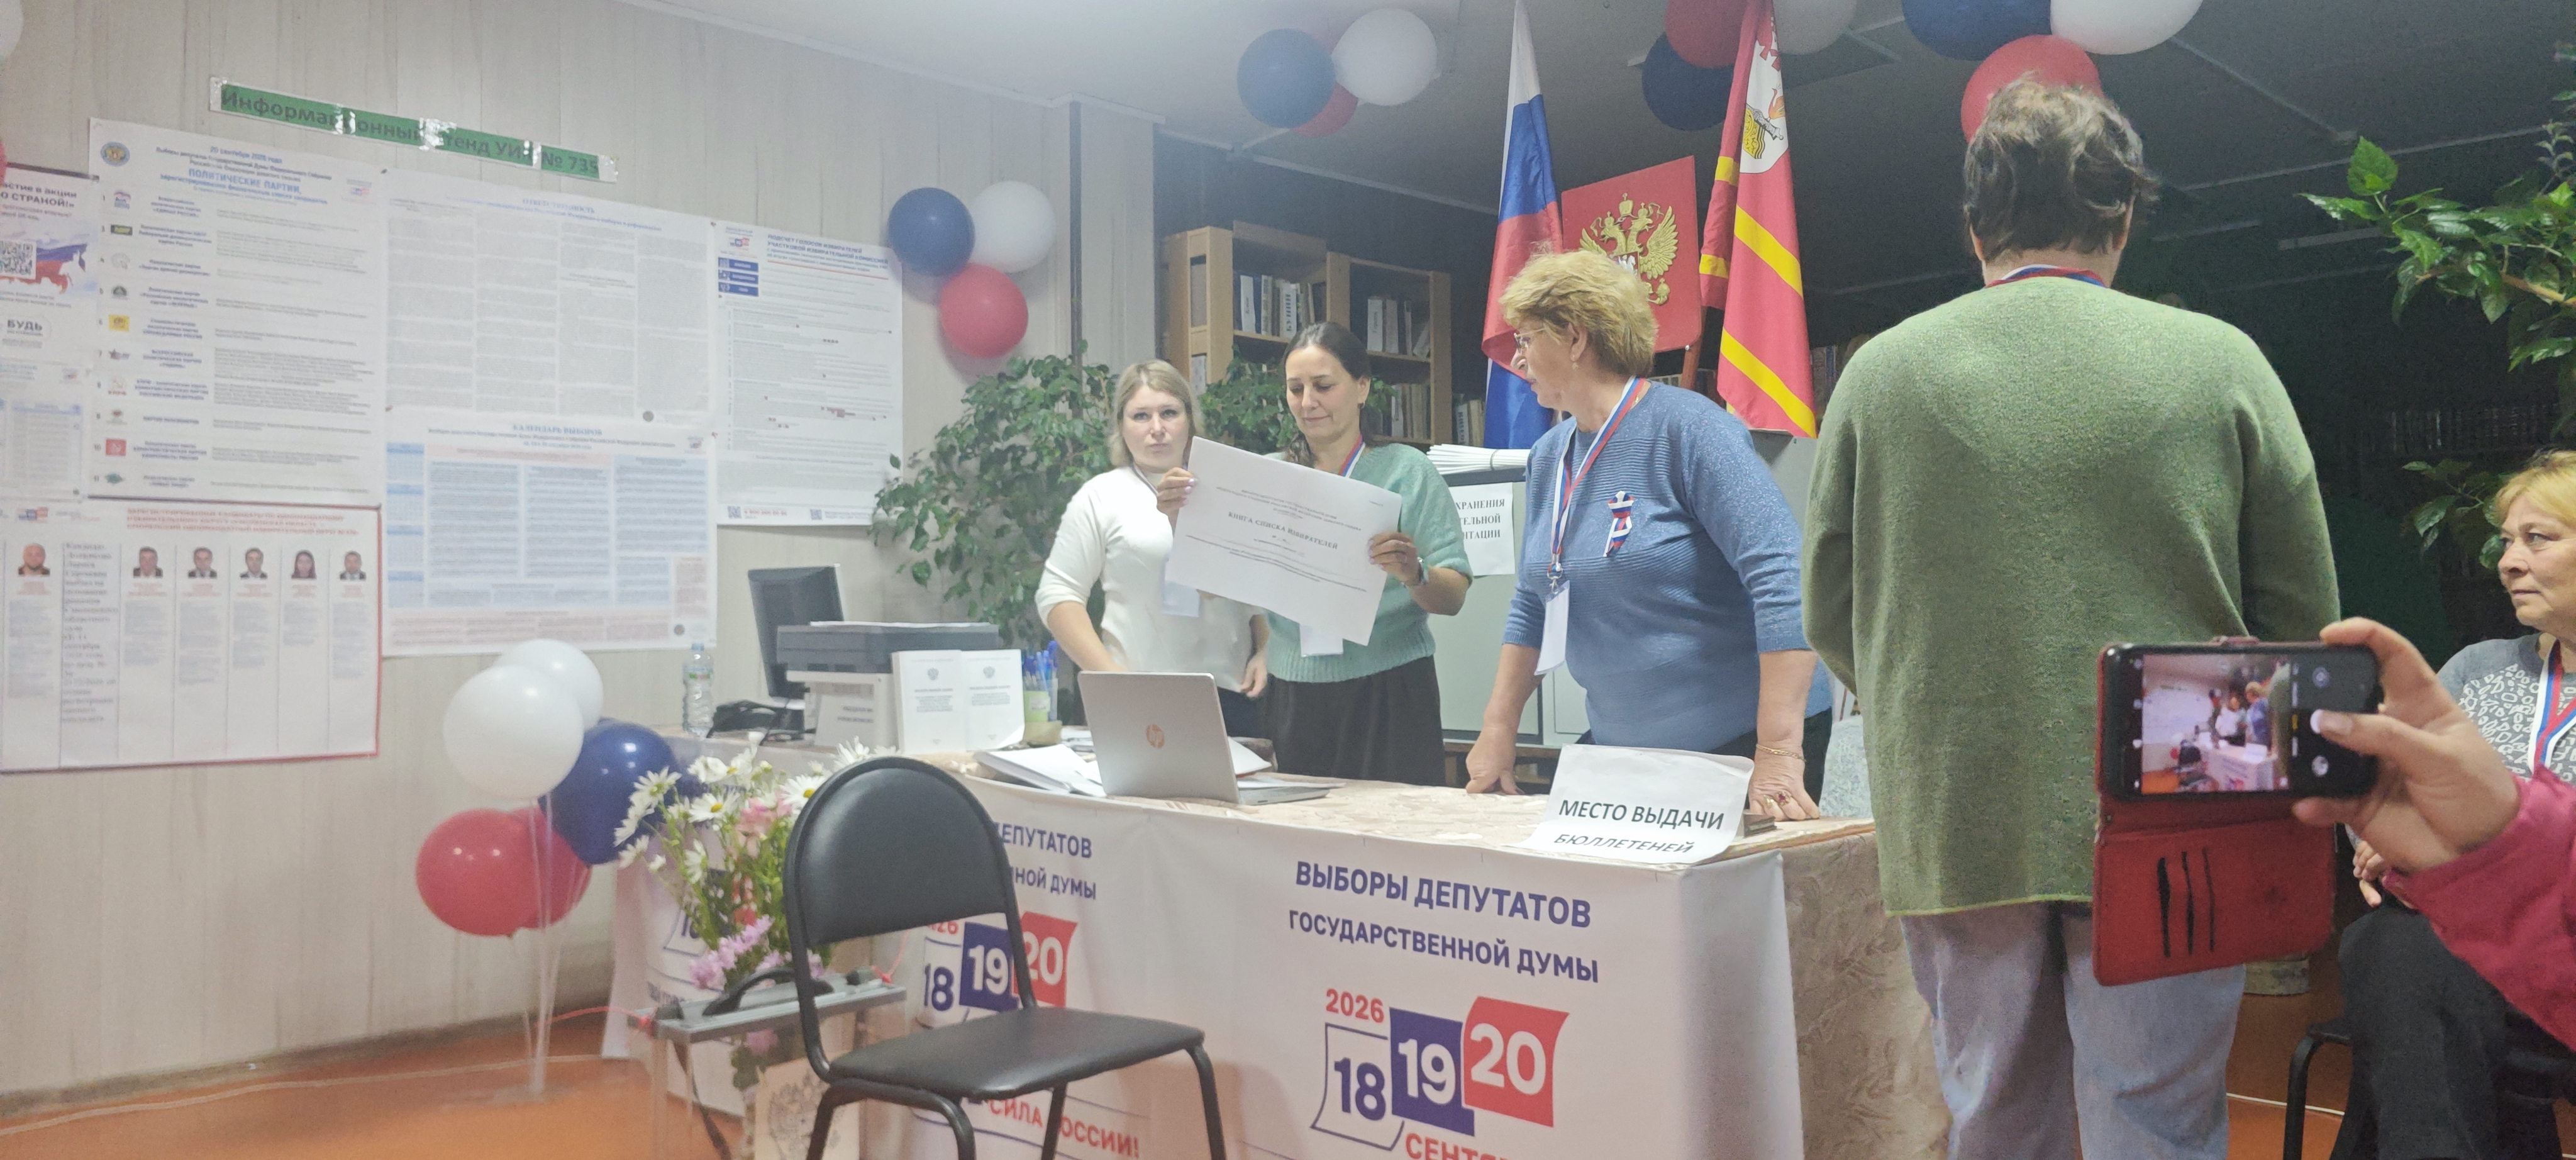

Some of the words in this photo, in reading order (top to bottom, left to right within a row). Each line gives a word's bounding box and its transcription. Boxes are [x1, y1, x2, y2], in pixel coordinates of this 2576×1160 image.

[439, 131, 491, 157] тенд
[541, 152, 562, 169] №
[567, 155, 599, 175] 735
[189, 167, 260, 188] ПОЛИТИЧЕСКИЕ
[767, 240, 806, 252] УЧАСТКОВОЙ
[807, 246, 855, 259] ИЗБИРАТЕЛЬНОЙ
[7, 318, 43, 332] БУДЬ
[1228, 511, 1253, 524] КНИГА
[1255, 519, 1286, 533] СПИСКА
[1287, 527, 1338, 550] ИЗБИРАТЕЛЕЙ
[1558, 800, 1628, 821] МЕСТО
[1631, 805, 1725, 830] ВЫДАЧИ
[994, 822, 1092, 859] ЕПУТАТОВ
[1553, 833, 1697, 854] БЮЛЛЕТЕНЕЙ
[1050, 873, 1096, 900] ДУМЫ
[1296, 861, 1408, 901] ВЫБОРЫ
[1414, 878, 1592, 929] ДЕПУТАТОВ
[1289, 910, 1511, 969] ГОСУДАРСТВЕННОЙ
[1516, 947, 1599, 984] ДУМЫ
[924, 962, 955, 1012] 18
[968, 944, 1009, 995] 19
[1023, 931, 1064, 986] 20
[1325, 988, 1385, 1024] 2026
[1333, 1057, 1387, 1122] 18
[1397, 1037, 1457, 1106] 19
[1469, 1022, 1548, 1096] 20
[989, 1098, 1043, 1128] СИЛА
[1059, 1115, 1140, 1158] ОССИИ!
[1405, 1132, 1511, 1160] СЕНТ
